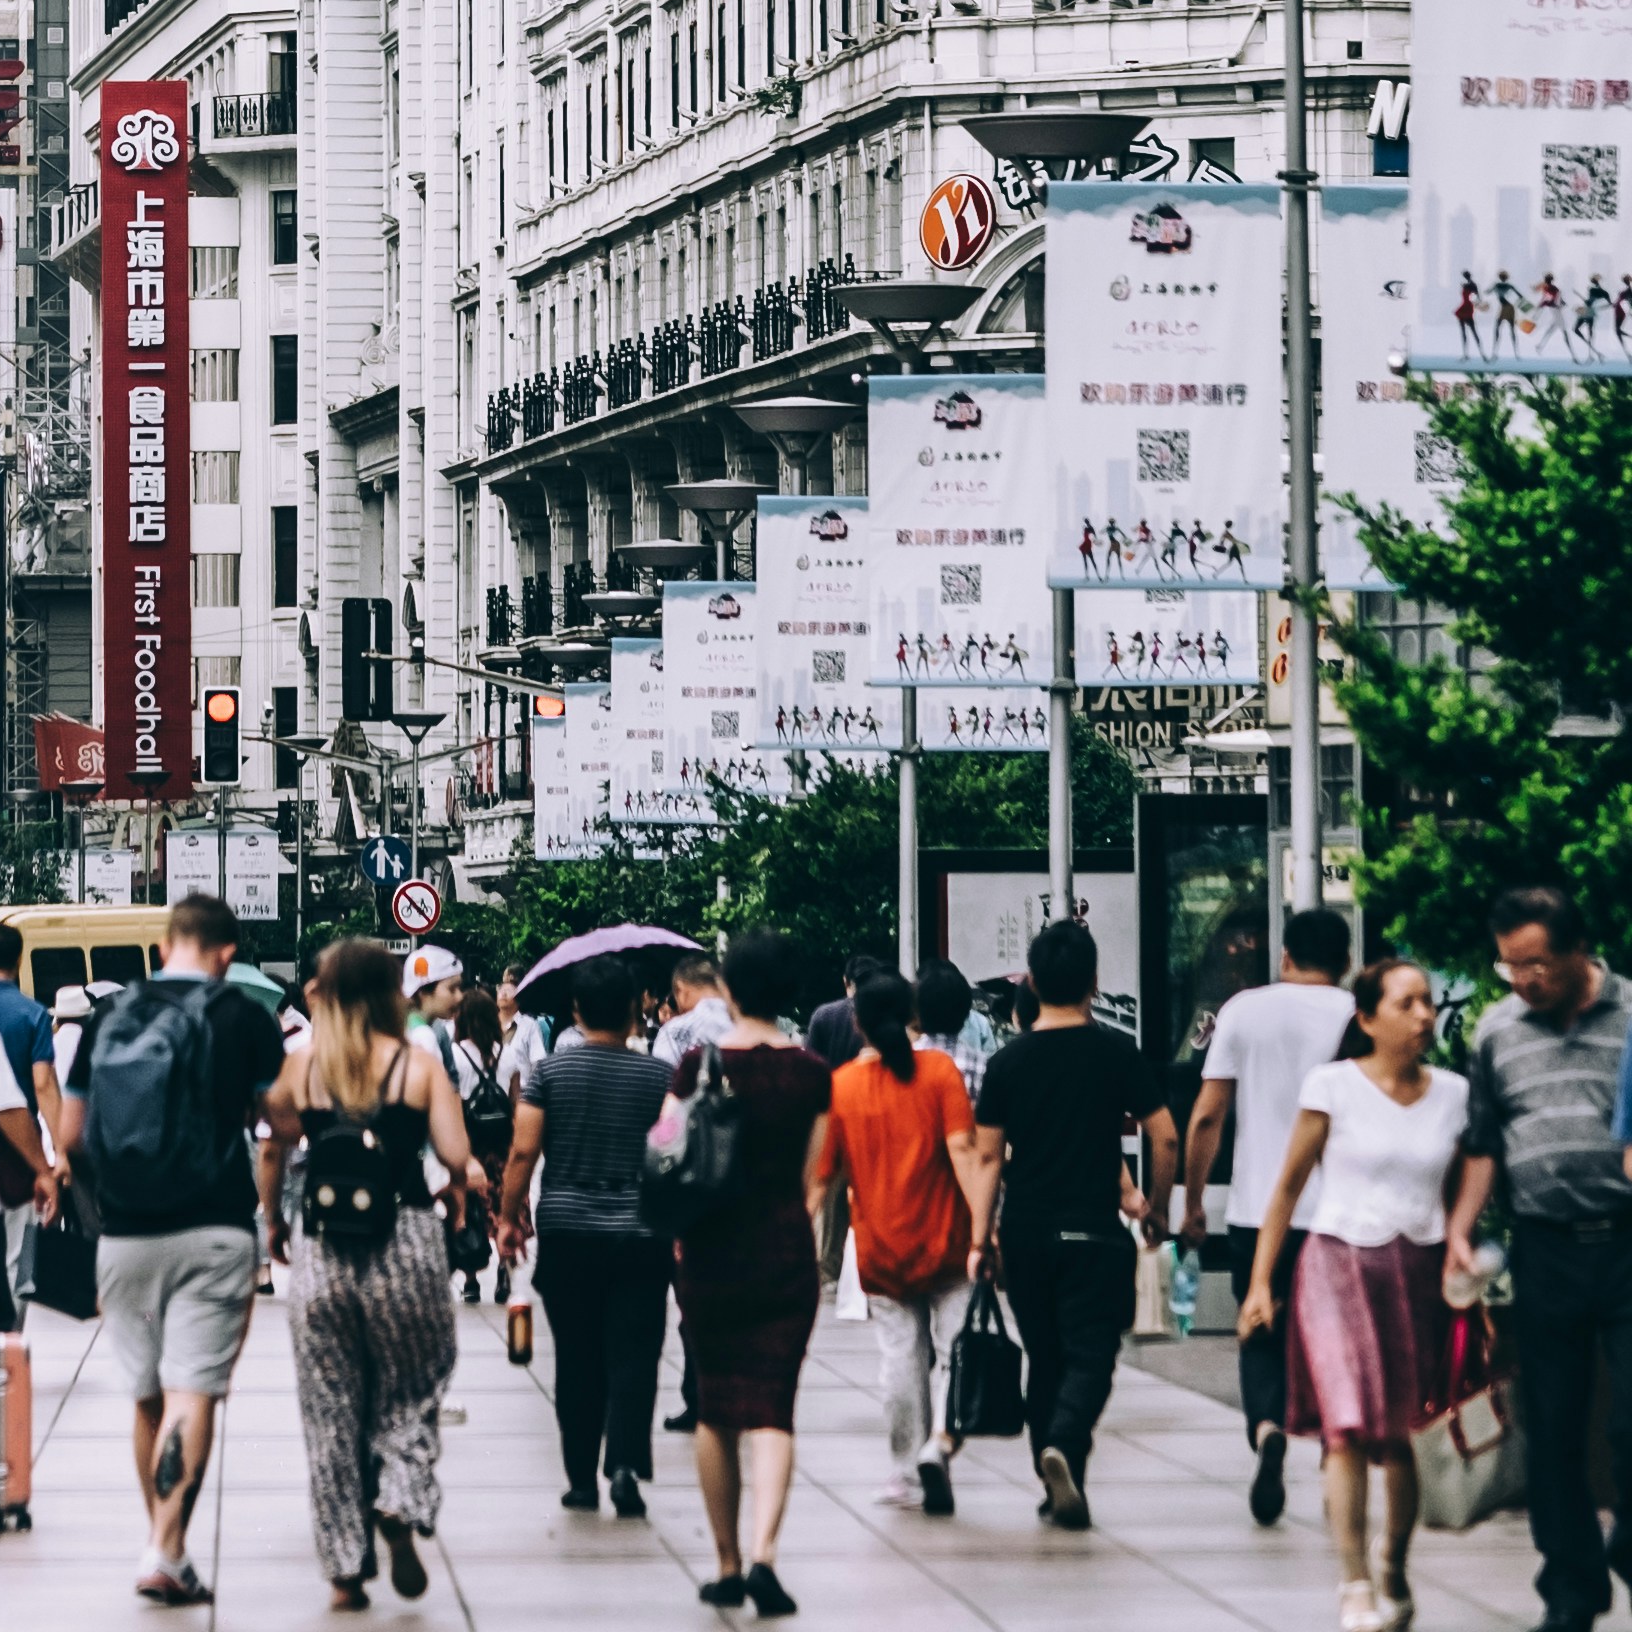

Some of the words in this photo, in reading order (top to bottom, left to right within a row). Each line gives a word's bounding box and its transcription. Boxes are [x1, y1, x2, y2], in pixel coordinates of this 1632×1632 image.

[127, 190, 166, 543] 上海市第一食品商店
[134, 565, 162, 625] First
[134, 634, 163, 772] Foodhall
